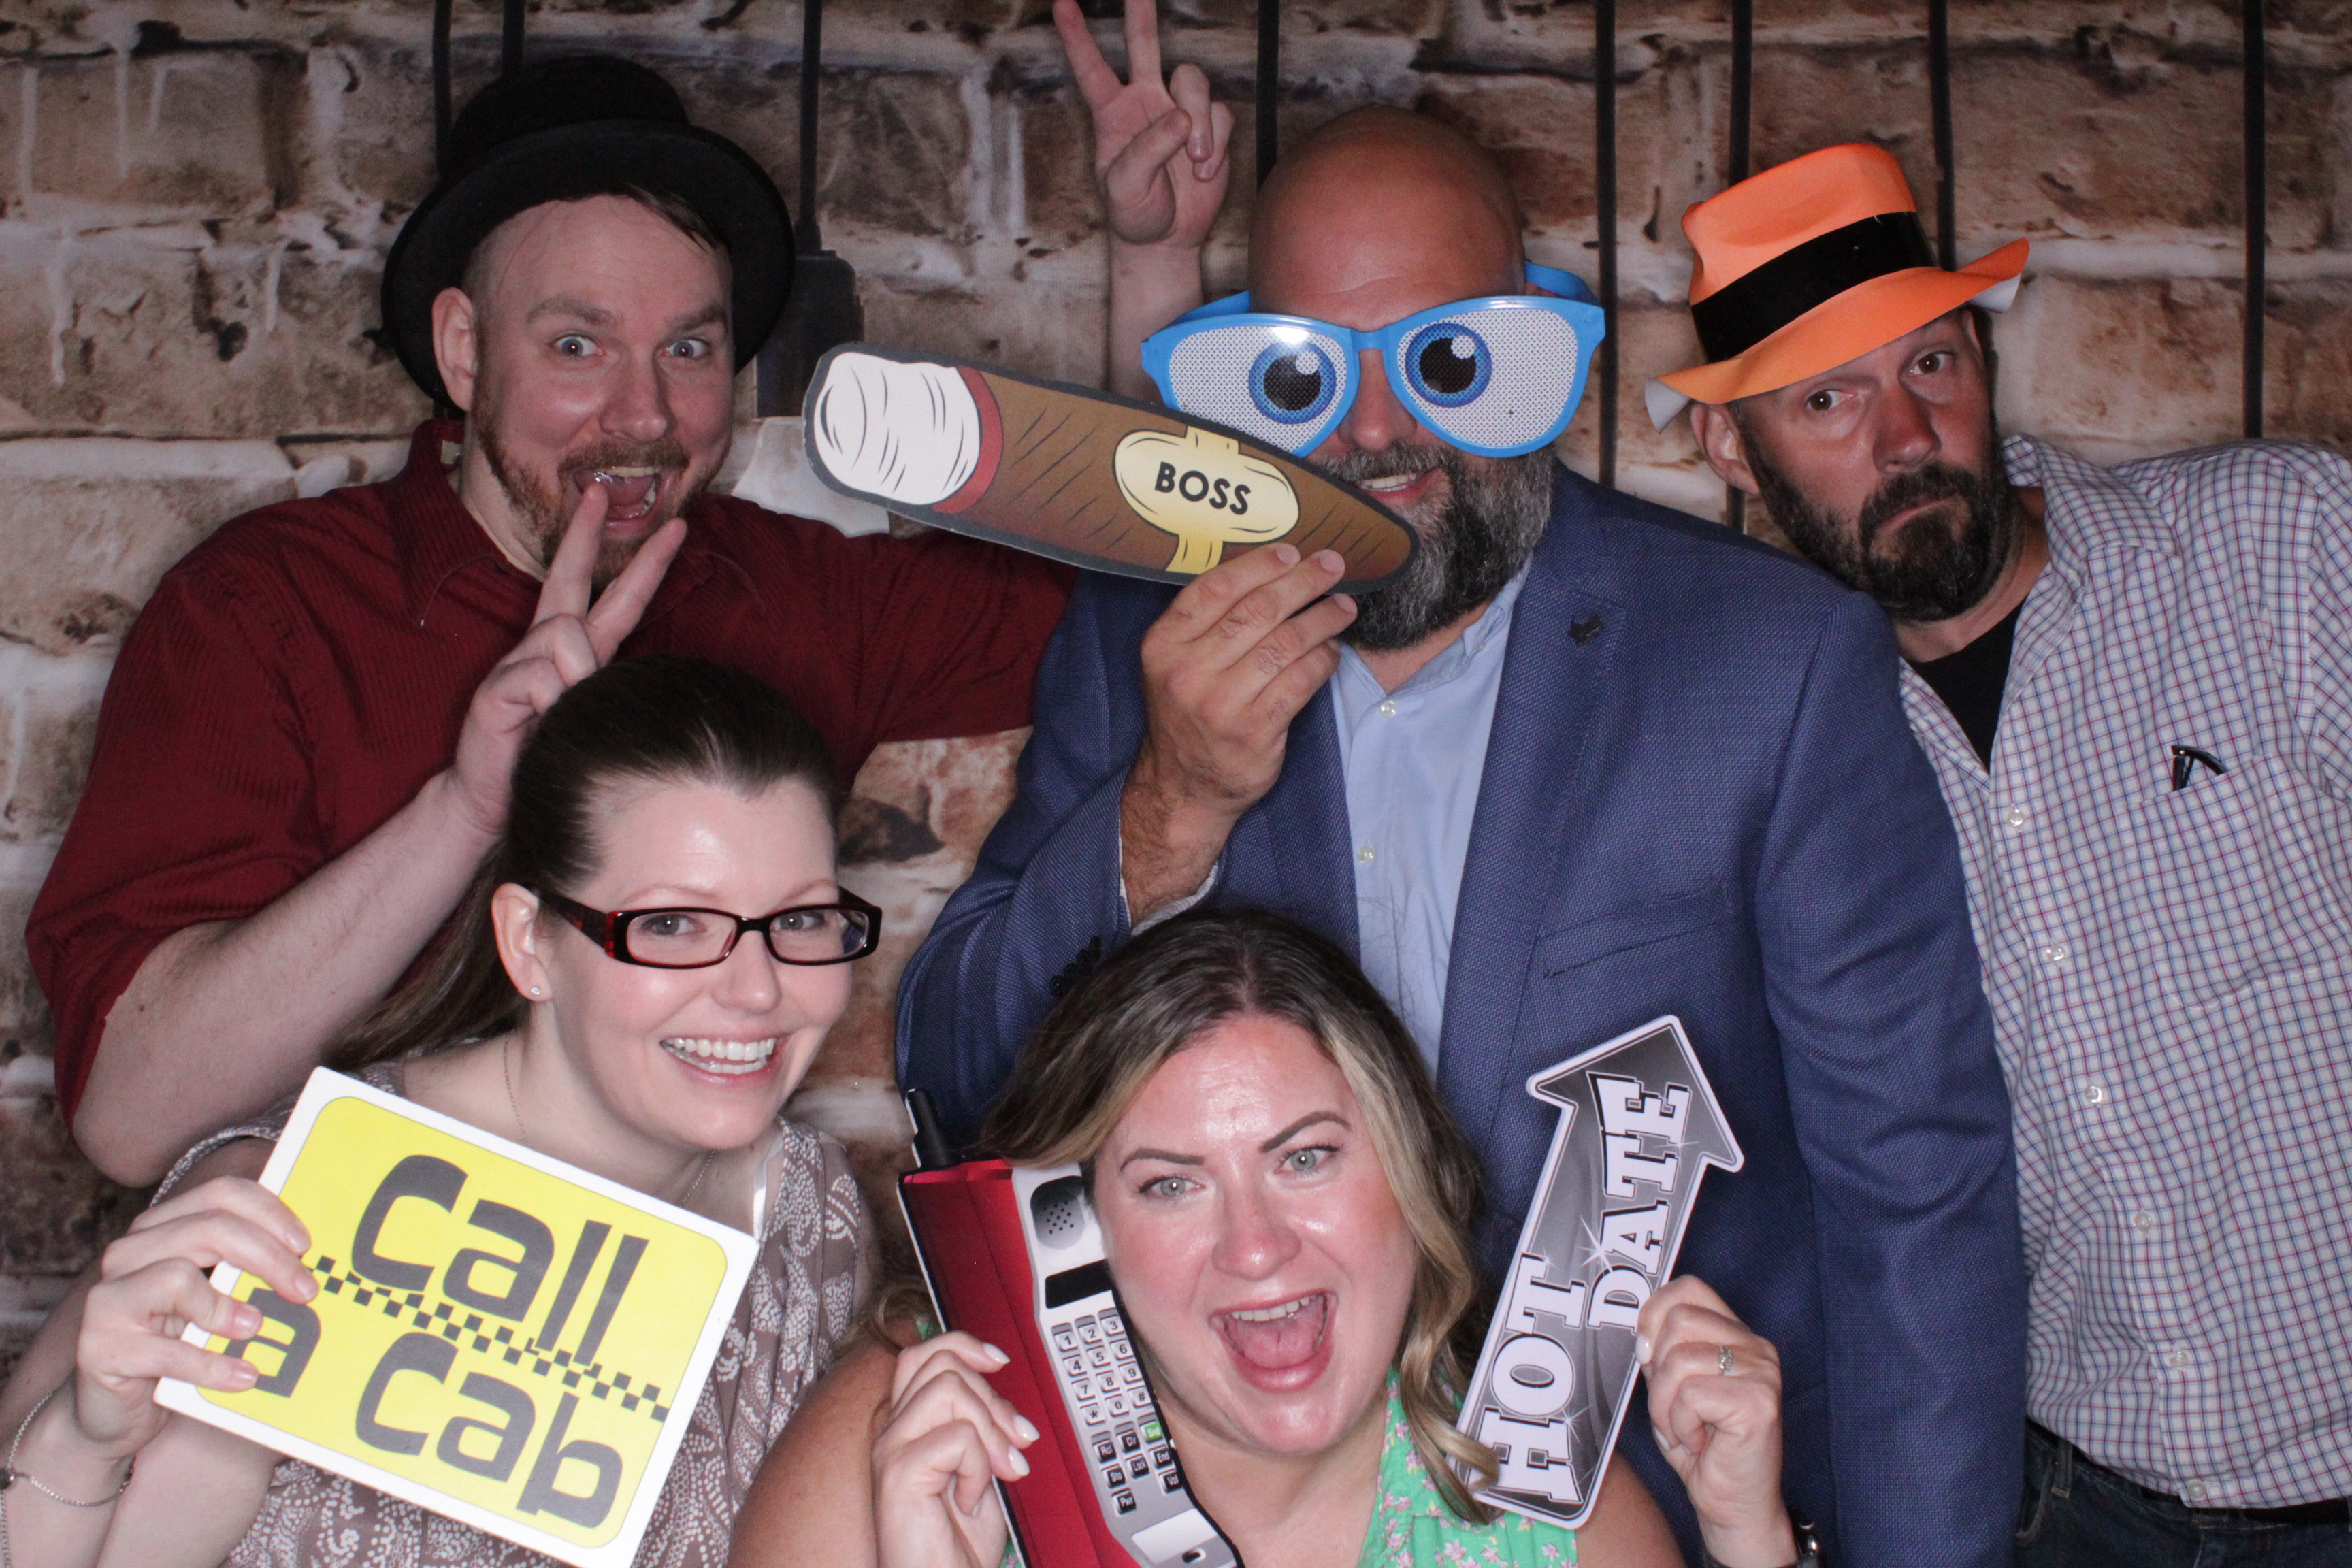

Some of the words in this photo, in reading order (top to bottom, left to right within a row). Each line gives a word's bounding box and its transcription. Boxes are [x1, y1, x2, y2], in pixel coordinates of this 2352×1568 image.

[1154, 461, 1251, 515] BOSS
[1586, 1071, 1691, 1335] DATE
[351, 1154, 650, 1364] Call
[224, 1287, 322, 1398] a
[1064, 1335, 1072, 1345] 1
[1088, 1328, 1097, 1339] 2
[1109, 1320, 1118, 1330] 3
[1073, 1360, 1082, 1371] 4
[1096, 1352, 1105, 1362] 5
[1119, 1344, 1128, 1354] 6
[1081, 1384, 1089, 1394] 7
[1105, 1377, 1114, 1386] 8
[1128, 1368, 1137, 1377] 9
[1467, 1253, 1584, 1503] HOT
[1115, 1401, 1122, 1410] 0
[1137, 1391, 1146, 1403] #
[1100, 1445, 1113, 1456] Rcl
[1126, 1436, 1137, 1447] Clr
[1147, 1426, 1161, 1437] Snd
[1110, 1471, 1123, 1482] Sto
[1157, 1453, 1171, 1464] End
[1166, 1475, 1180, 1486] Vol
